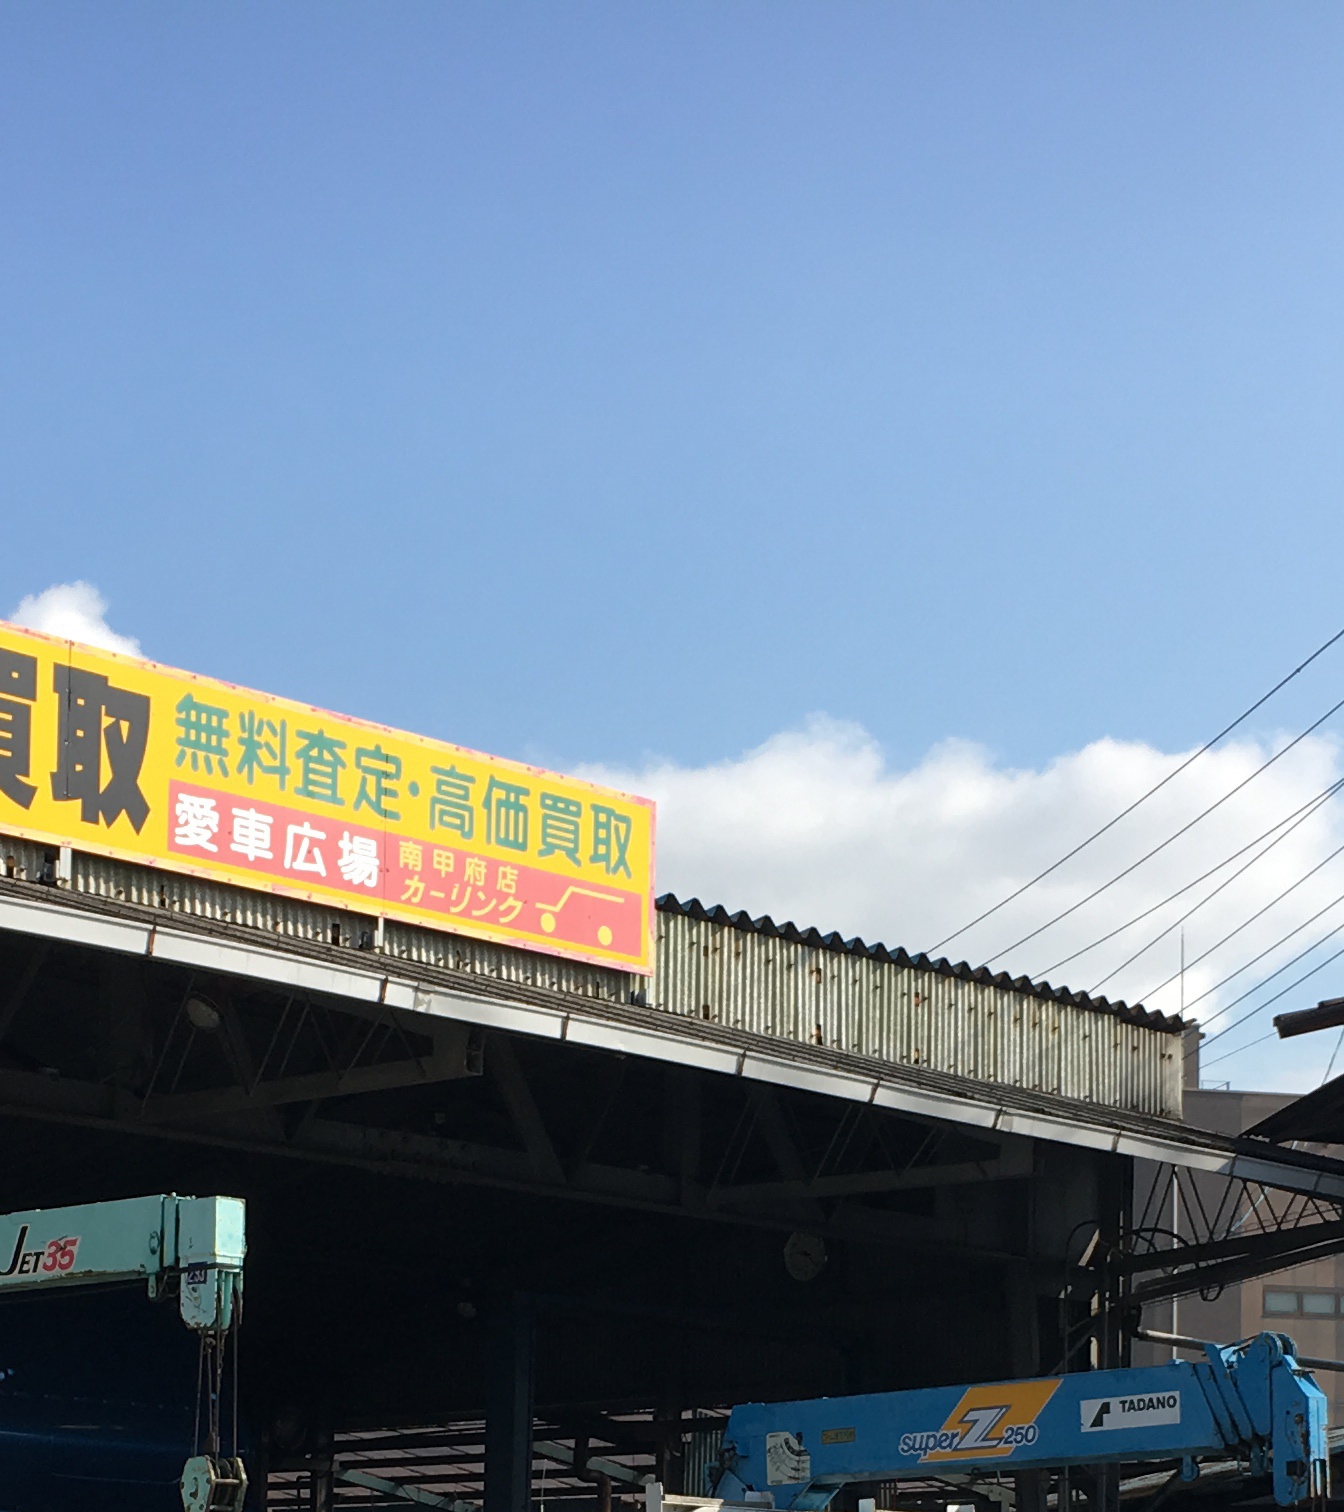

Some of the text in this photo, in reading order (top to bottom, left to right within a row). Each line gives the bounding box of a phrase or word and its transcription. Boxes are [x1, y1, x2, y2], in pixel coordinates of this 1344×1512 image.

[174, 692, 634, 880] 無料査定・高価買取
[174, 793, 380, 889] 愛車広場
[399, 840, 519, 895] 南甲府店
[400, 875, 523, 924] カーリンク
[1119, 1395, 1178, 1413] TADANO
